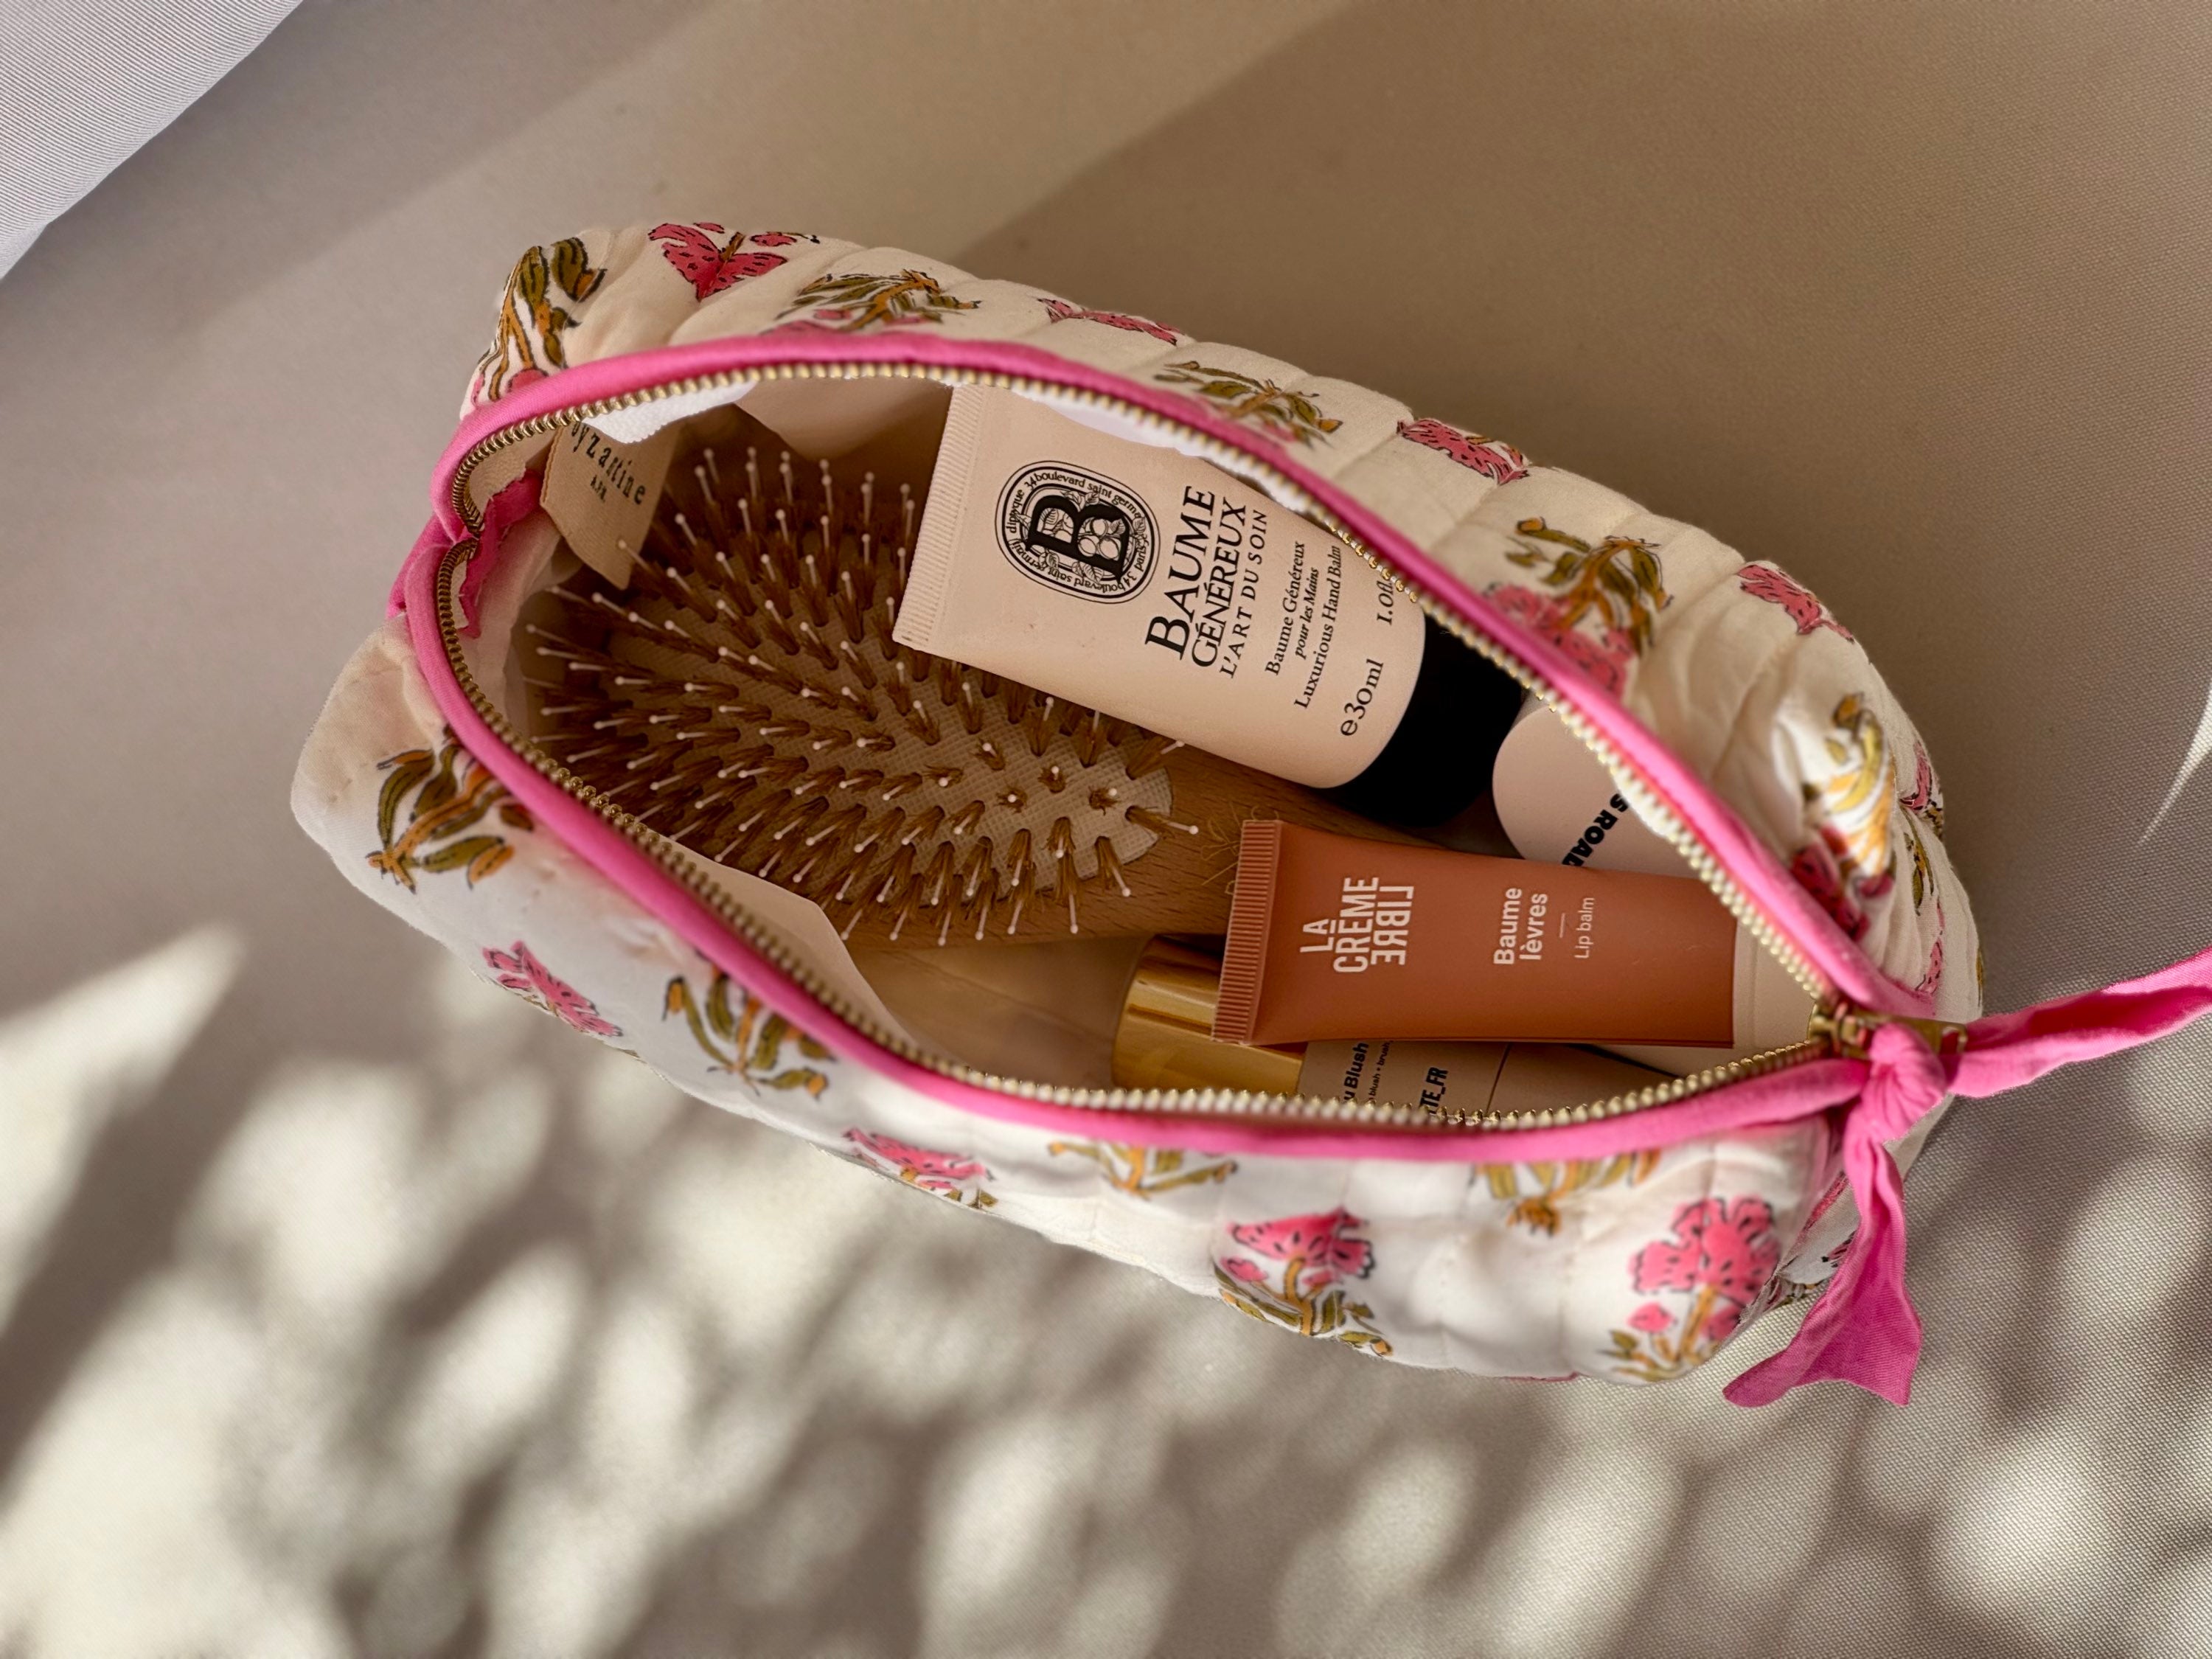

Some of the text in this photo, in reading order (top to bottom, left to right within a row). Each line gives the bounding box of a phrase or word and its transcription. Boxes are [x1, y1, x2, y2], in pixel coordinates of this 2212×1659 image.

[1024, 476, 1037, 490] 34
[1034, 470, 1086, 487] boulevard
[1088, 482, 1112, 498] saint
[1025, 495, 1130, 585] B
[1048, 566, 1072, 582] saint
[1144, 486, 1215, 661] BAUME
[1122, 571, 1137, 587] 34
[1191, 497, 1246, 667] GÉNÉREUX
[1220, 509, 1267, 678] L'ART DU SOIN
[1265, 541, 1305, 675] Baume Généreux
[1295, 567, 1319, 660] pour les Mains
[1293, 546, 1342, 709] Luxurious Hand Balm
[1300, 919, 1335, 953] LA
[1493, 888, 1522, 964] Baume
[1519, 894, 1548, 960] lèvres
[1574, 897, 1595, 959] Lip balm
[1343, 1042, 1369, 1089] Blush
[1368, 1074, 1380, 1096] blush
